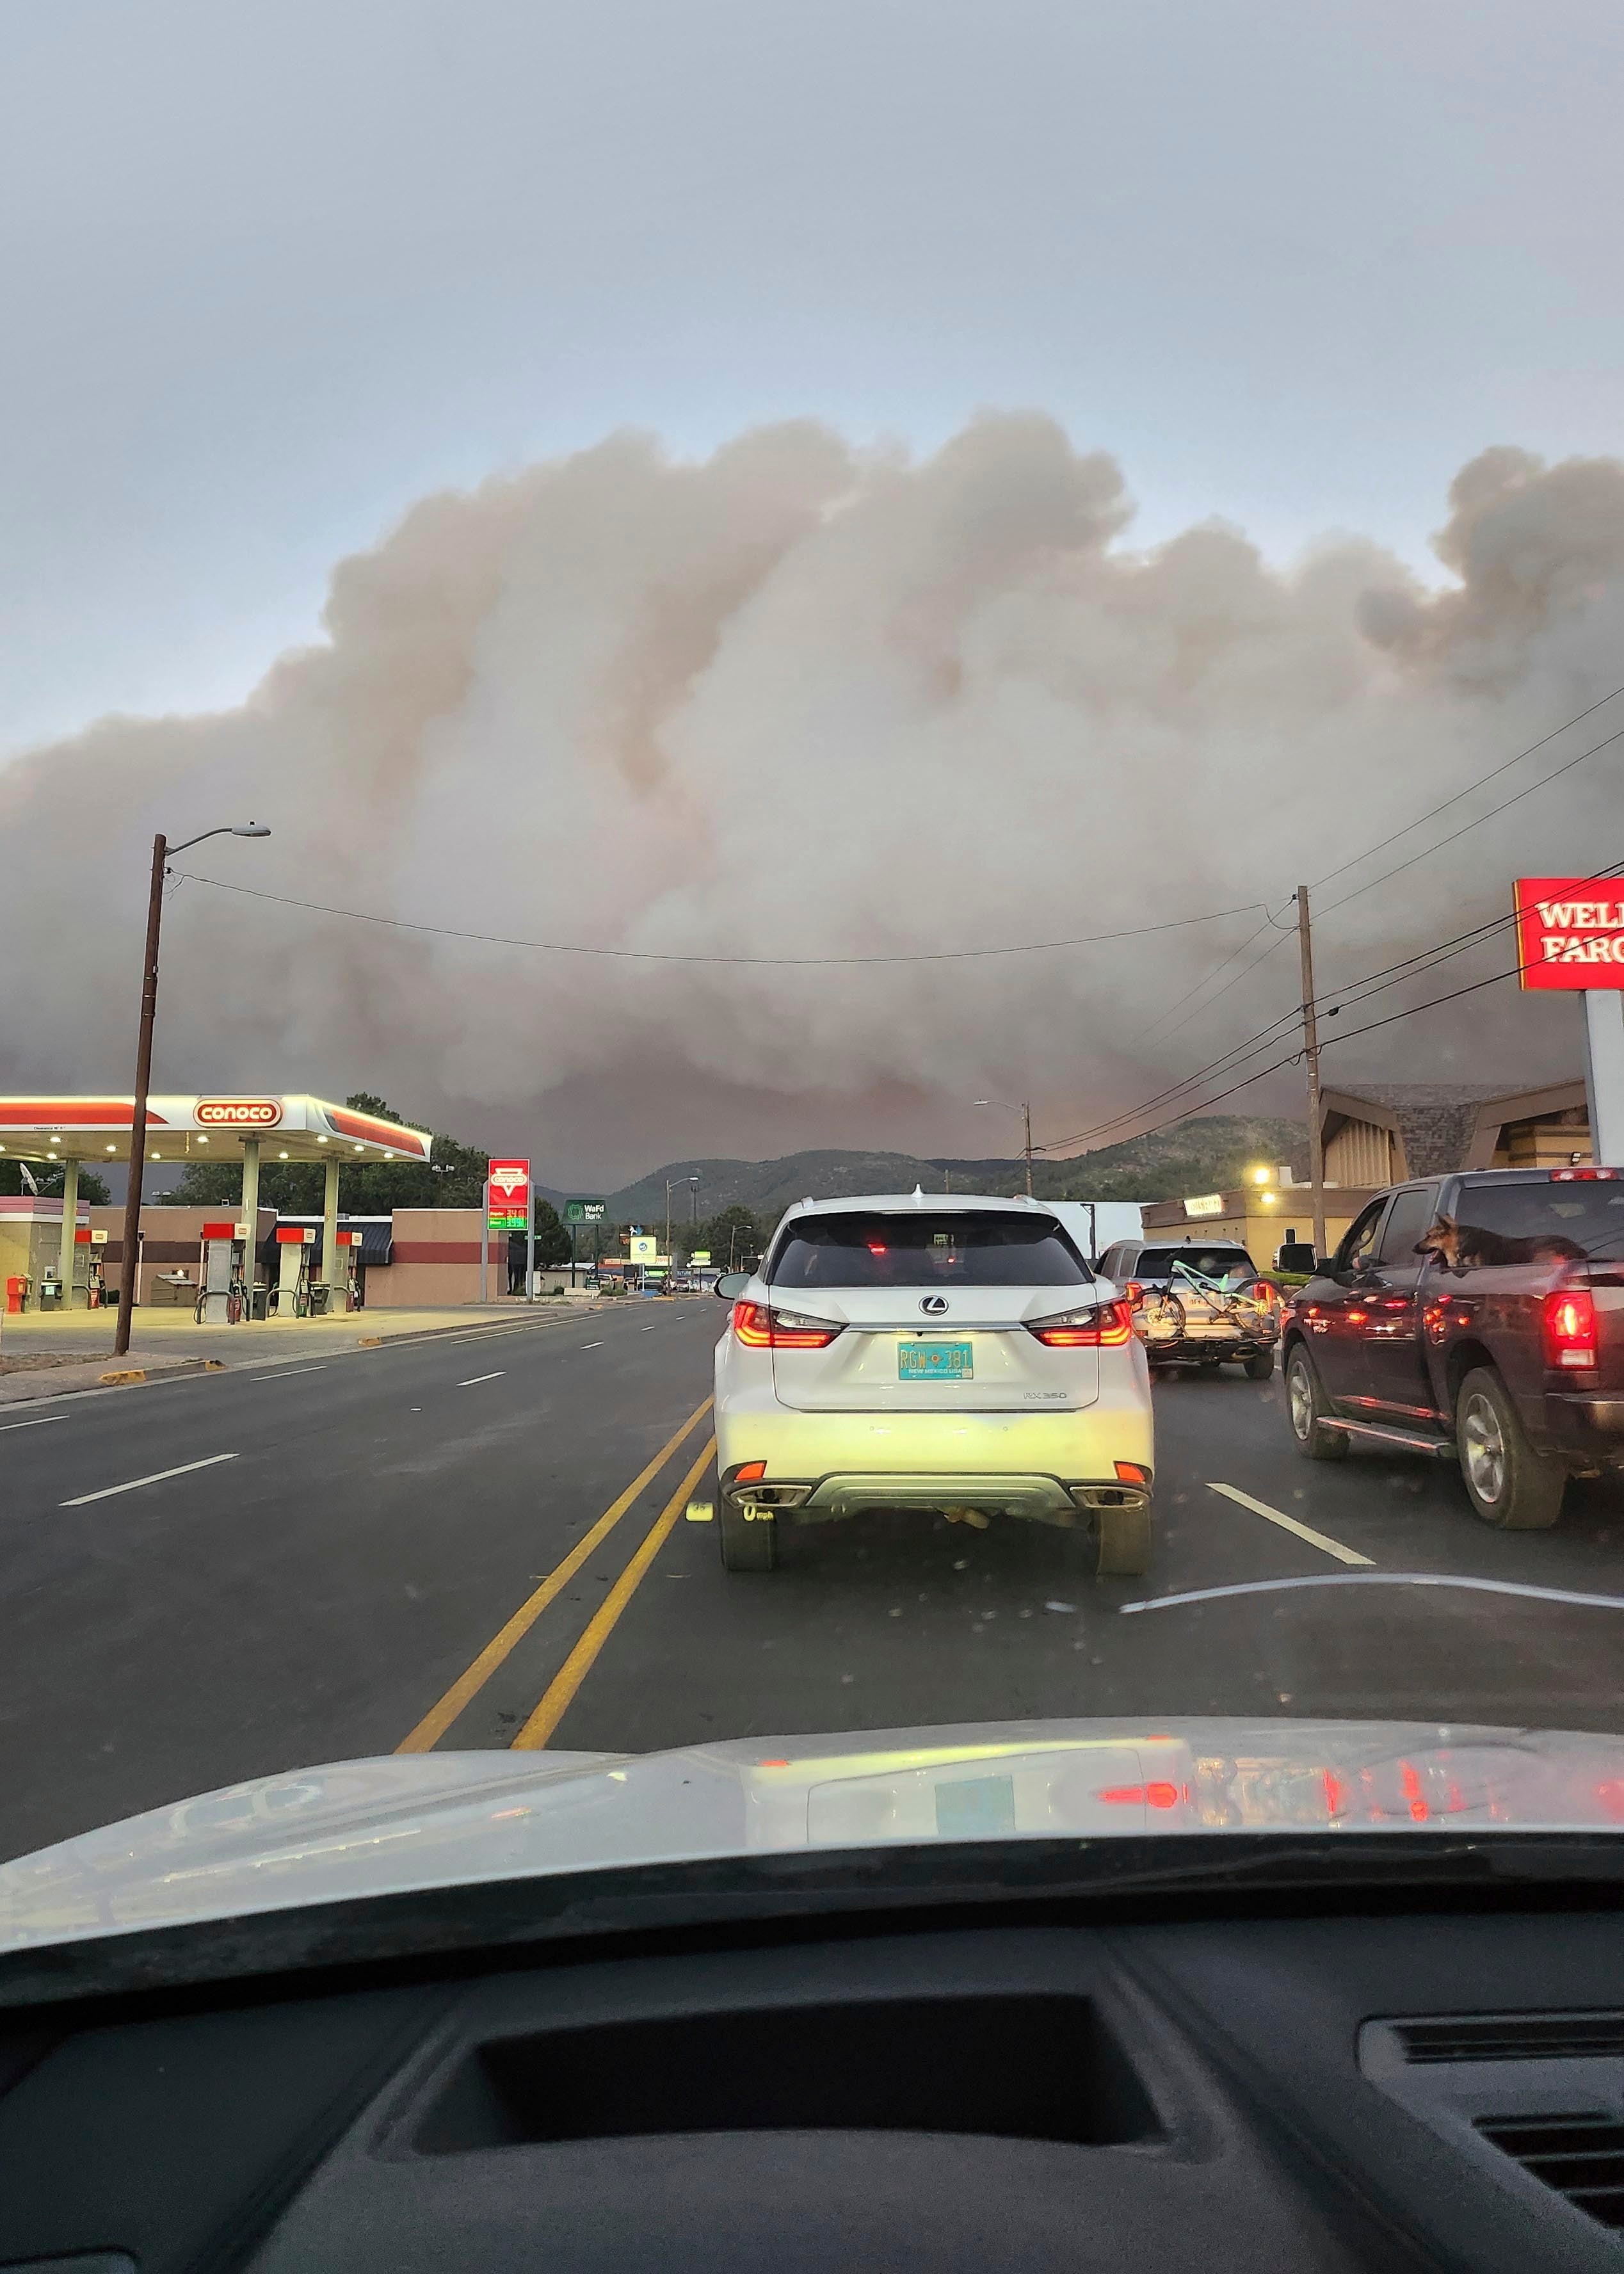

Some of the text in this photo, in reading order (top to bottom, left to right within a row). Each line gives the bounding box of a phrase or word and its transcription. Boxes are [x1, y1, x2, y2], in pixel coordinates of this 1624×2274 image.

[584, 1204, 604, 1213] WaFd
[585, 1212, 602, 1220] Bank
[901, 1349, 969, 1369] RGW 381
